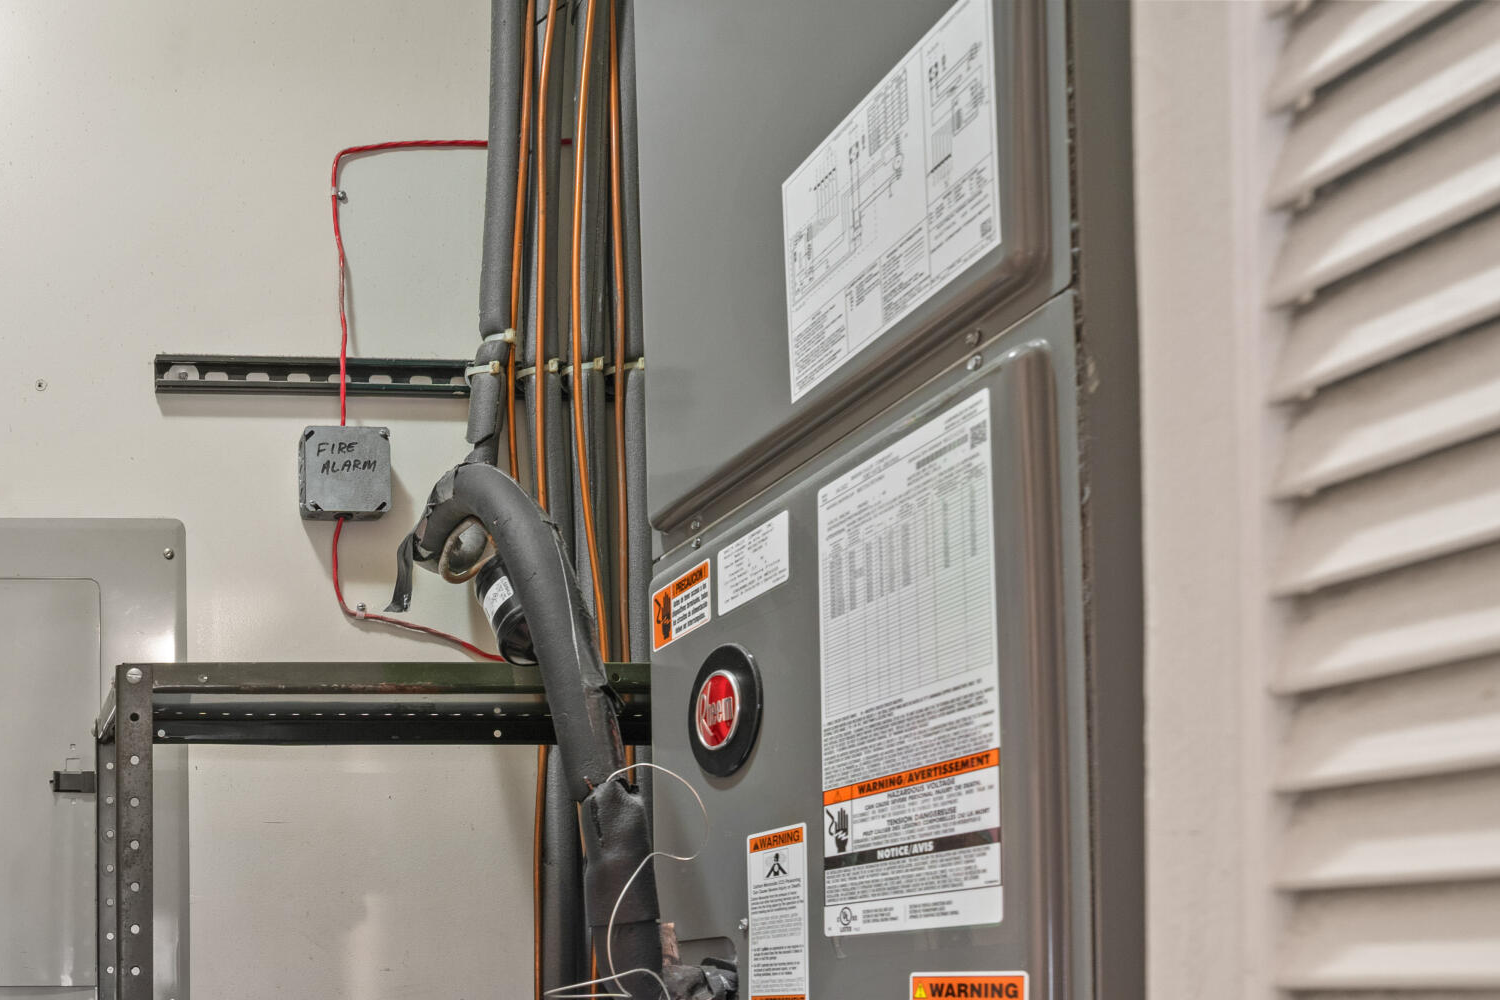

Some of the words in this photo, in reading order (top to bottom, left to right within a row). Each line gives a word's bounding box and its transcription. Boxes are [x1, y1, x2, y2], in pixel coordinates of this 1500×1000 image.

[317, 442, 358, 457] FIRE
[321, 460, 377, 475] ALARM
[699, 682, 733, 736] Rheem
[759, 830, 800, 850] WARNING
[929, 983, 1019, 999] WARNING
